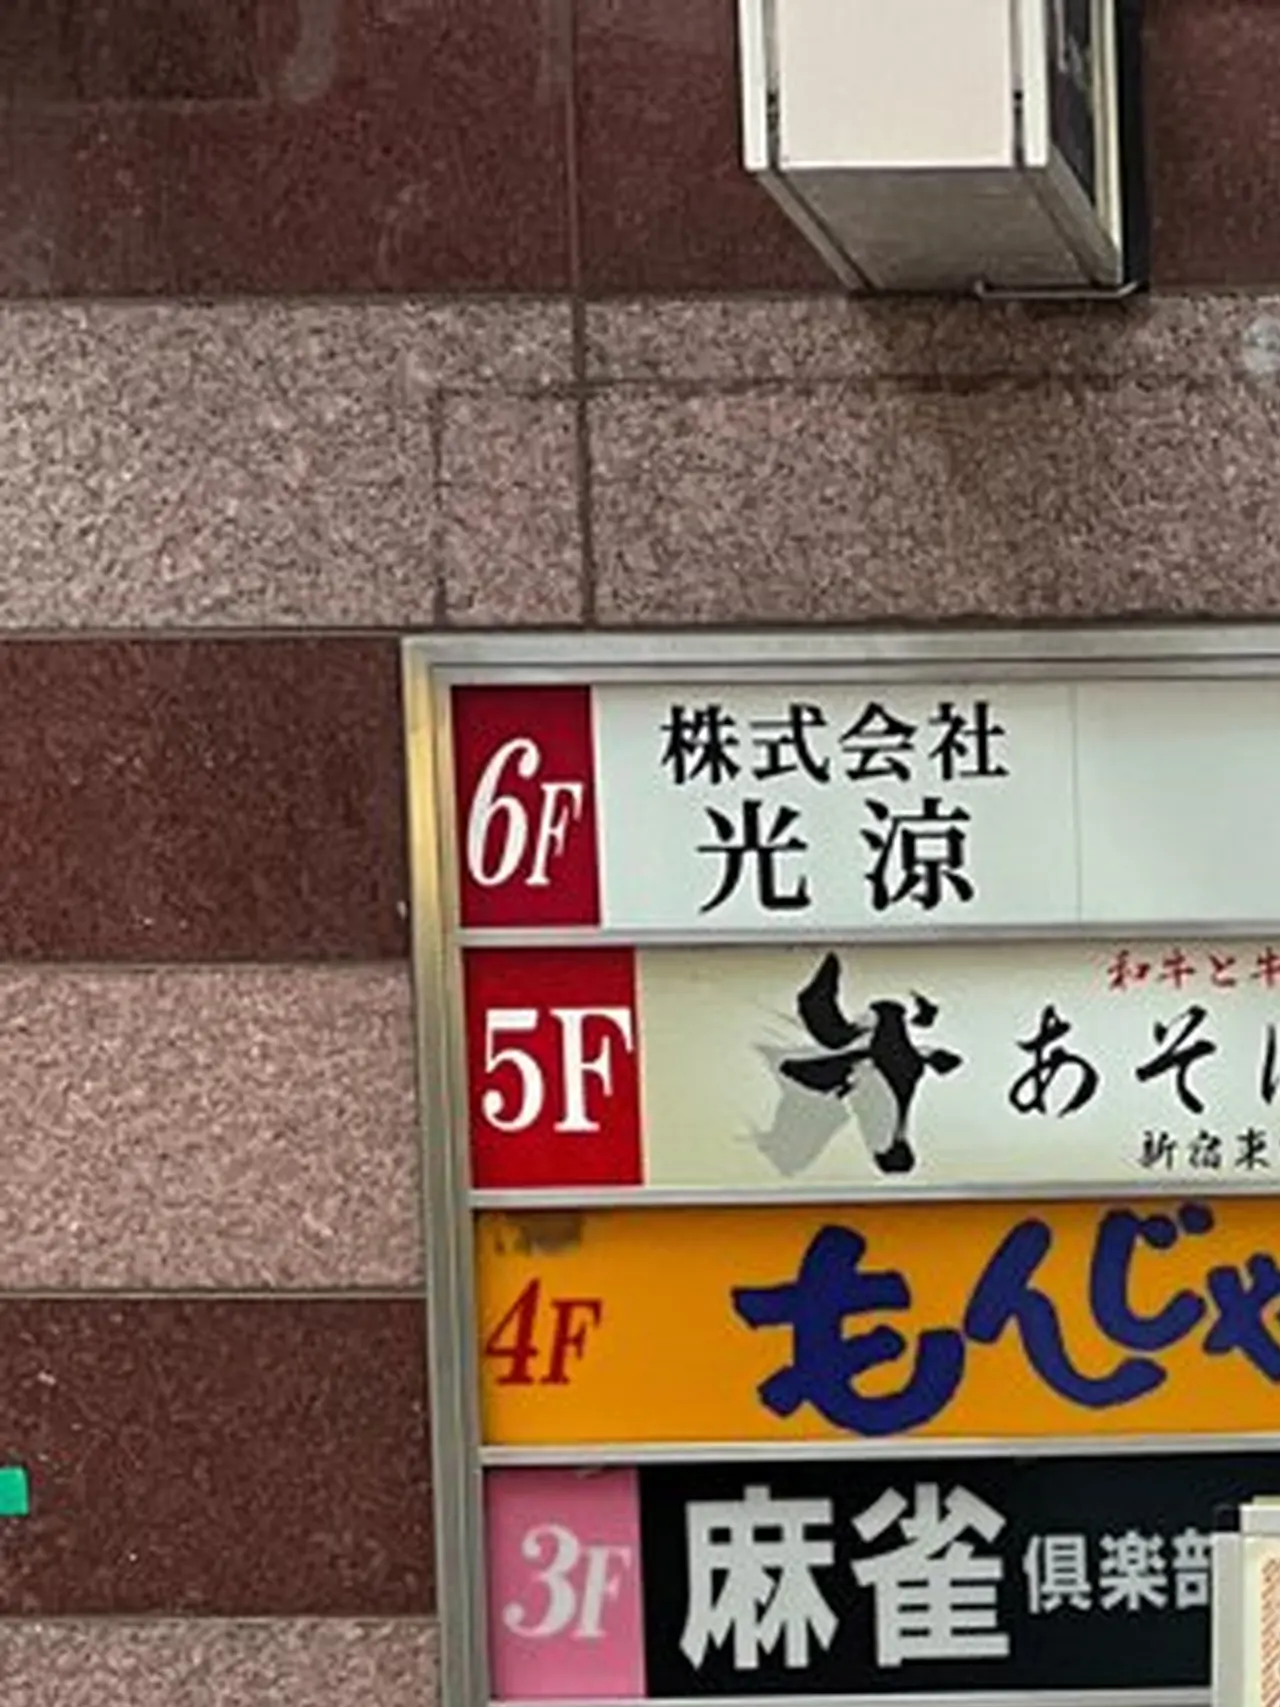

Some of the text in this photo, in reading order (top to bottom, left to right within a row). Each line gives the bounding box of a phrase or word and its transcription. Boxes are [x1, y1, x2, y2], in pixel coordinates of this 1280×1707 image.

[659, 702, 1010, 785] 株式会社
[466, 737, 583, 887] 6F
[482, 1007, 632, 1133] 5F
[486, 1277, 601, 1387] 4F
[503, 1523, 631, 1641] 3F
